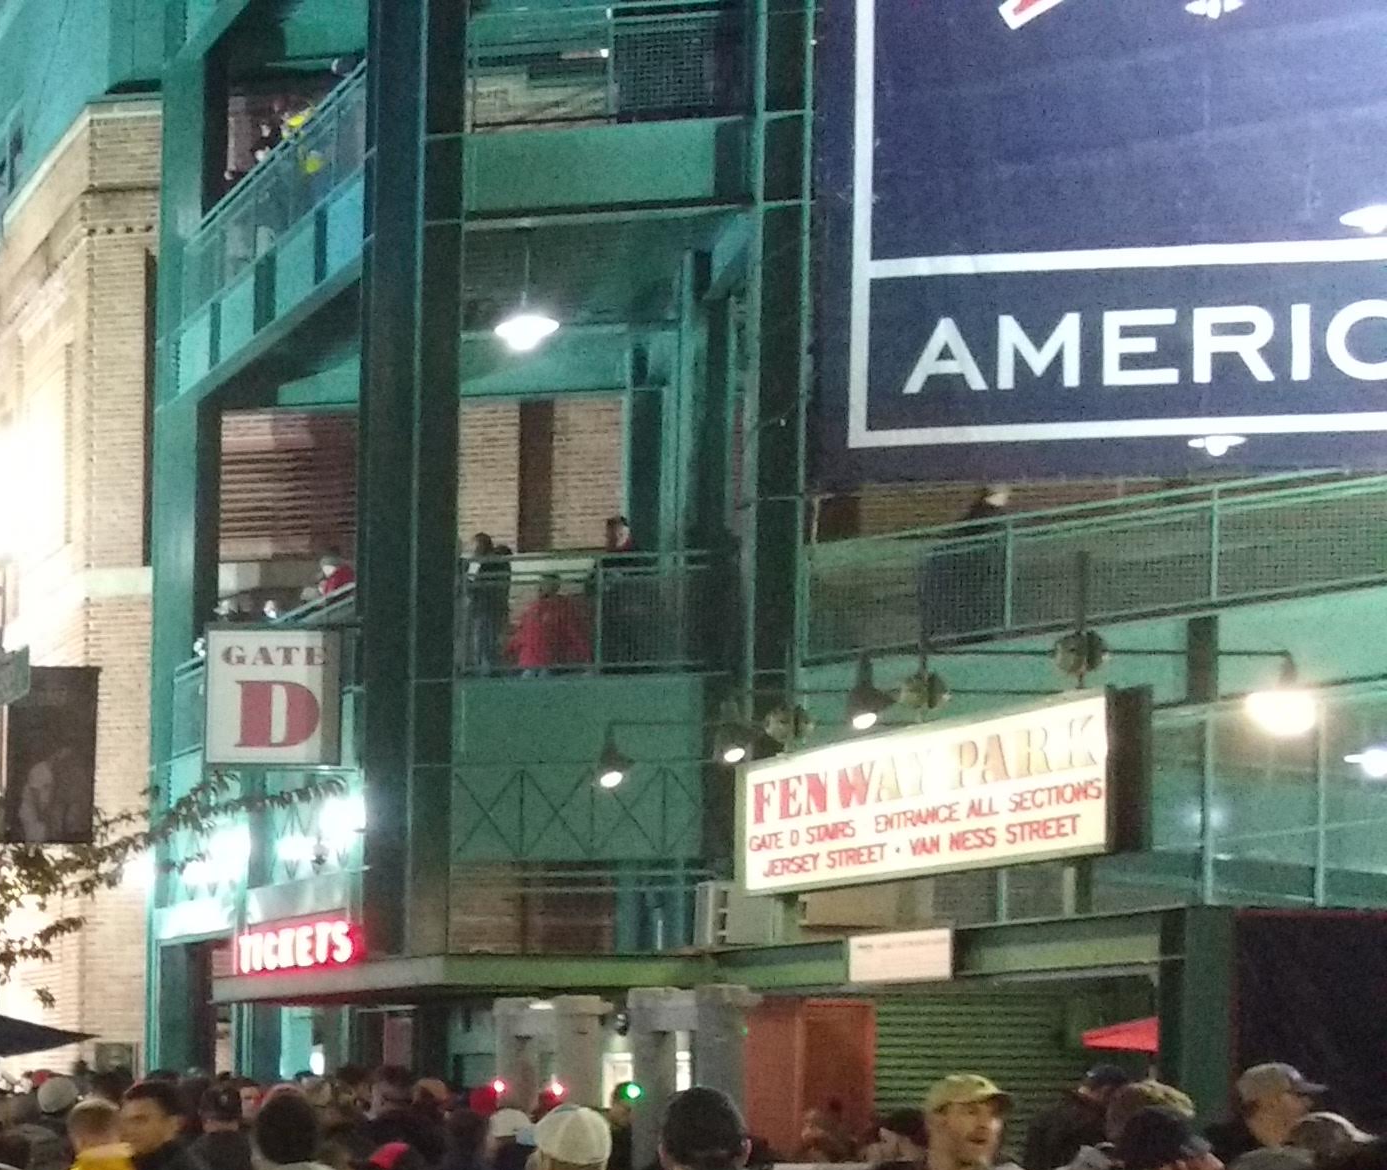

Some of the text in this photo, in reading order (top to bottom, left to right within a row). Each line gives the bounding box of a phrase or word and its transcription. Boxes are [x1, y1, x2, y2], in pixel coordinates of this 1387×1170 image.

[221, 645, 328, 667] GATE
[233, 679, 320, 748] D
[751, 713, 1100, 825] FENWAY PARK
[749, 778, 1102, 852] GATE D STAIRS ENTRANCE ALL SECTIONS
[763, 814, 1081, 878] JERSEY STREET VAN NESS STREET
[238, 920, 353, 975] TICKETS
